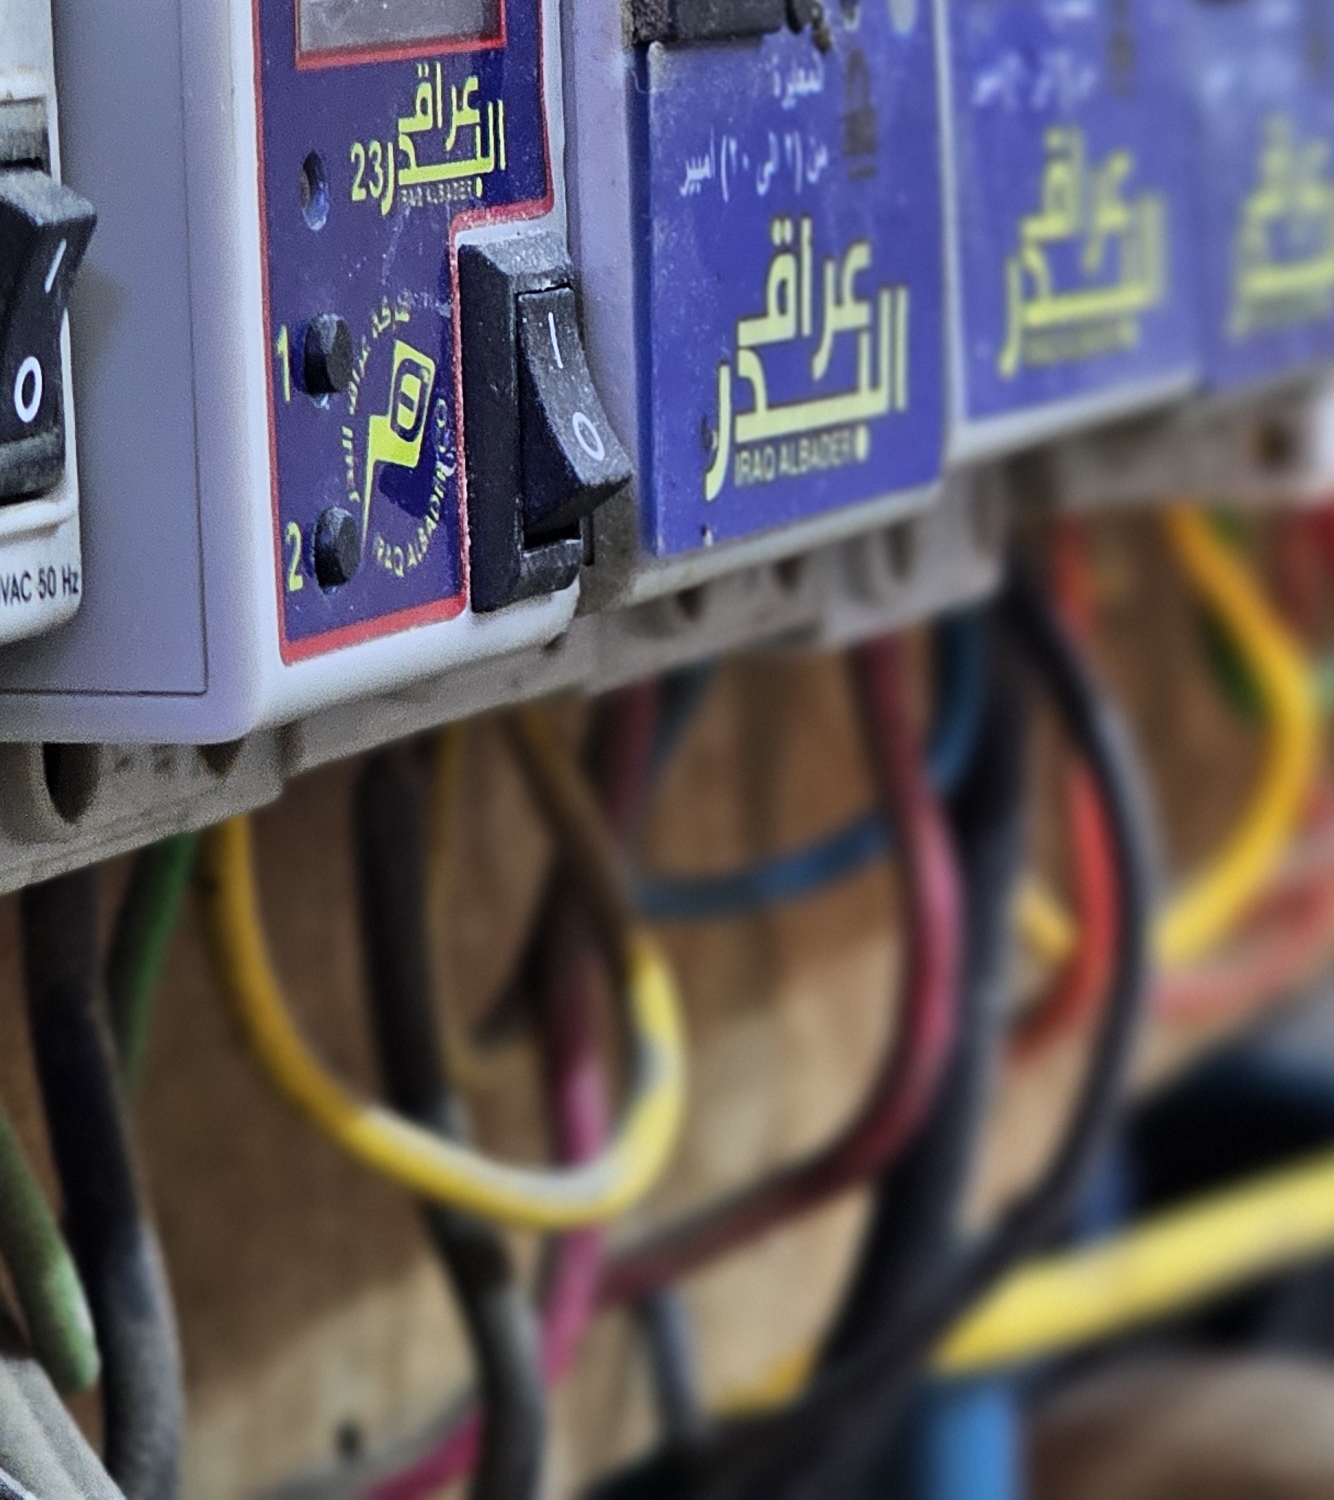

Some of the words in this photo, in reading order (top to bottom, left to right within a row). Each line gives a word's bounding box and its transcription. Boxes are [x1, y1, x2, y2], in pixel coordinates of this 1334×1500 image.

[350, 139, 383, 202] 23
[37, 563, 57, 602] 50
[61, 561, 80, 597] Hz
[285, 520, 304, 594] 2
